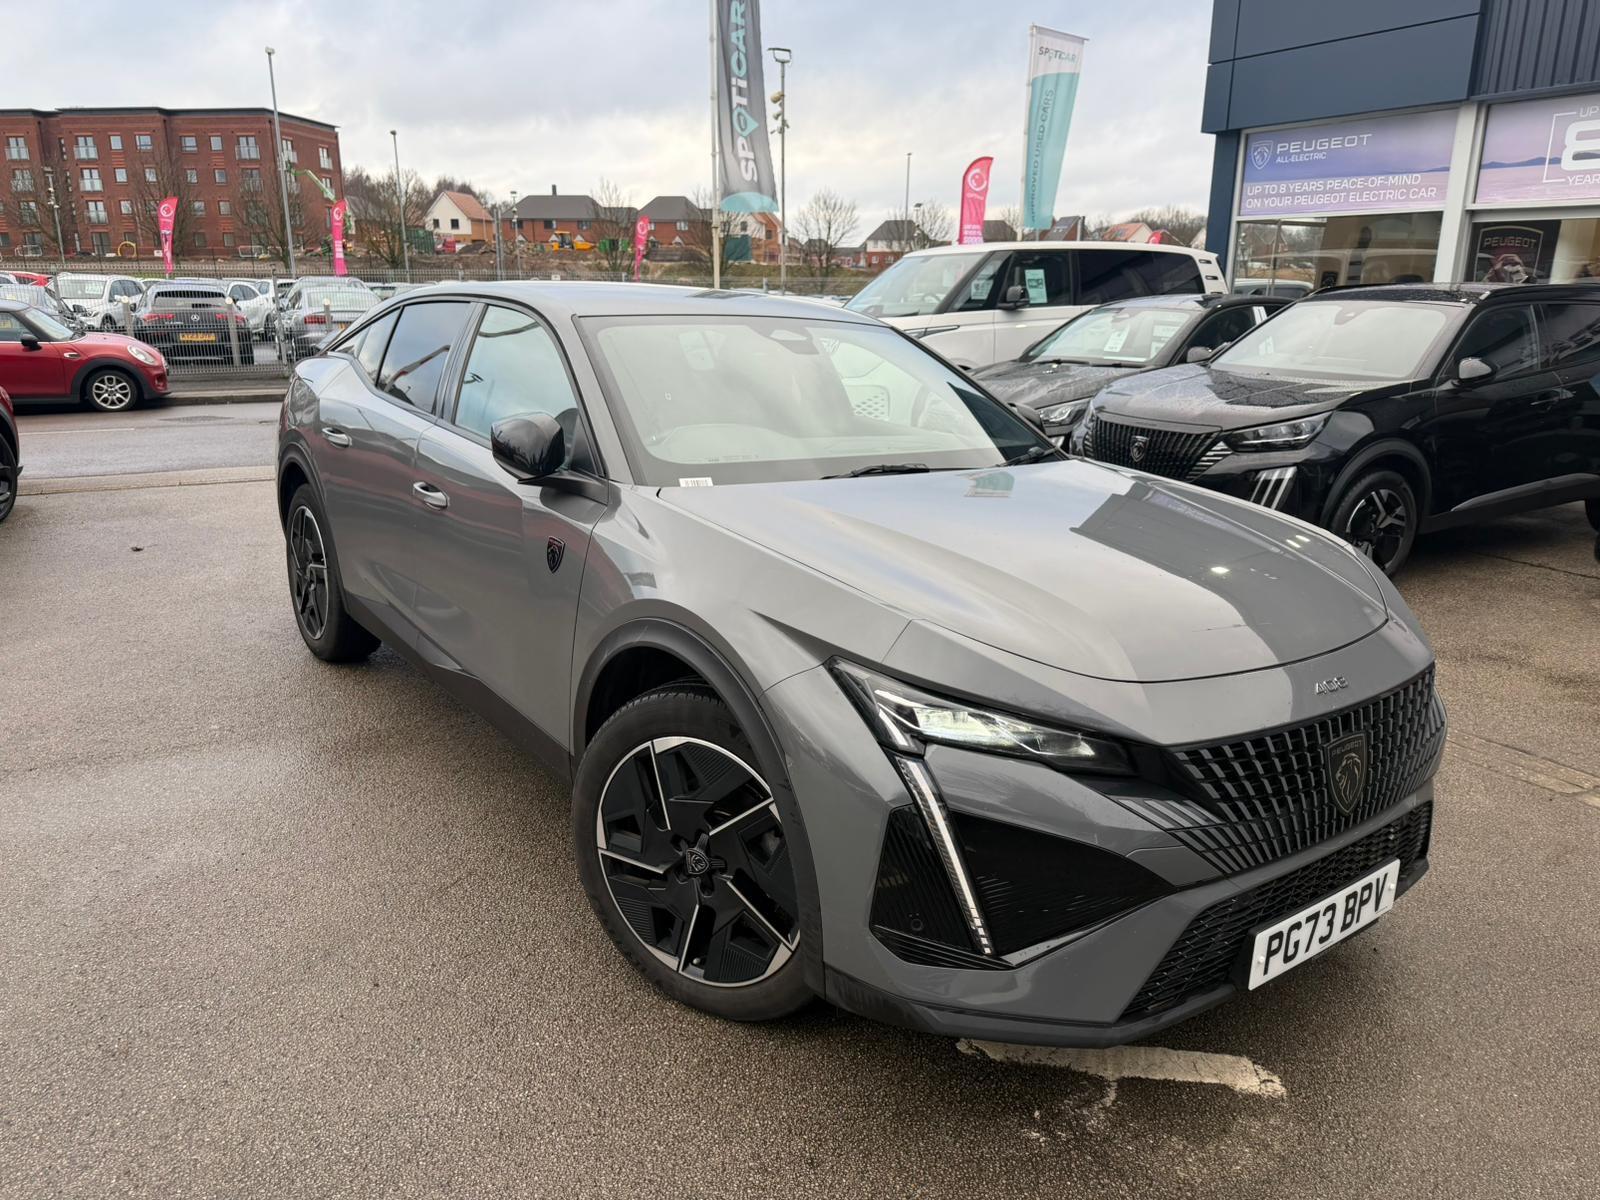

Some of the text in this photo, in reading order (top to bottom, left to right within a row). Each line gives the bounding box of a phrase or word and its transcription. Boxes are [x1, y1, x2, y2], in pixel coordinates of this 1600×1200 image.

[1034, 125, 1046, 158] USED
[1040, 88, 1055, 121] CARS
[1276, 134, 1372, 154] PEUGEOT
[1276, 152, 1327, 163] ALL-ELECTRIC
[1247, 174, 1421, 196] UP TO 8 YEARS PEACE-OF-MIND
[1246, 187, 1437, 208] ON YOUR PEUGEOT ELECTRIC CAR
[1483, 236, 1537, 249] PEUGEOT
[1263, 873, 1388, 976] PG73 BPV
